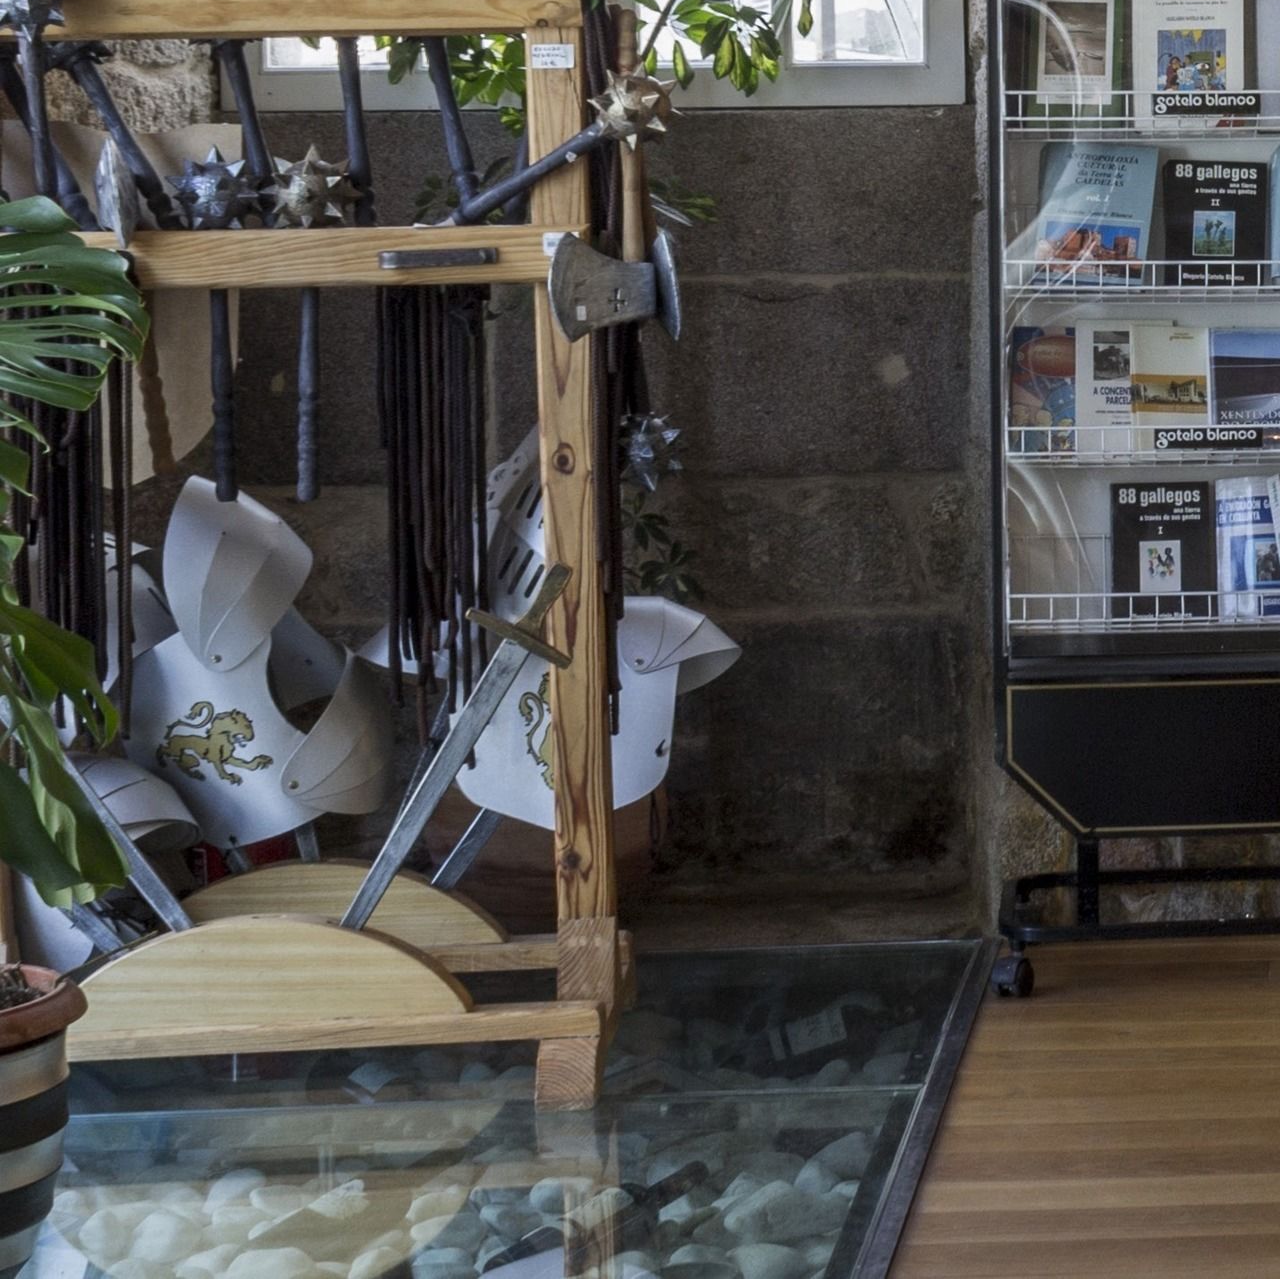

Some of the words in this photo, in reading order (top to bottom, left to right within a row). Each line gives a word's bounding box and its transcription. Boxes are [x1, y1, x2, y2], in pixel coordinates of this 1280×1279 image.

[1155, 93, 1202, 113] sotelo
[1205, 93, 1256, 106] blanco
[1175, 164, 1193, 178] 88
[1197, 164, 1257, 181] gallegos
[1093, 387, 1098, 395] A
[1220, 410, 1266, 419] XENTES
[1156, 429, 1203, 448] sotelo
[1207, 428, 1257, 441] blanco
[1119, 488, 1136, 504] 88
[1140, 487, 1200, 507] gallegos
